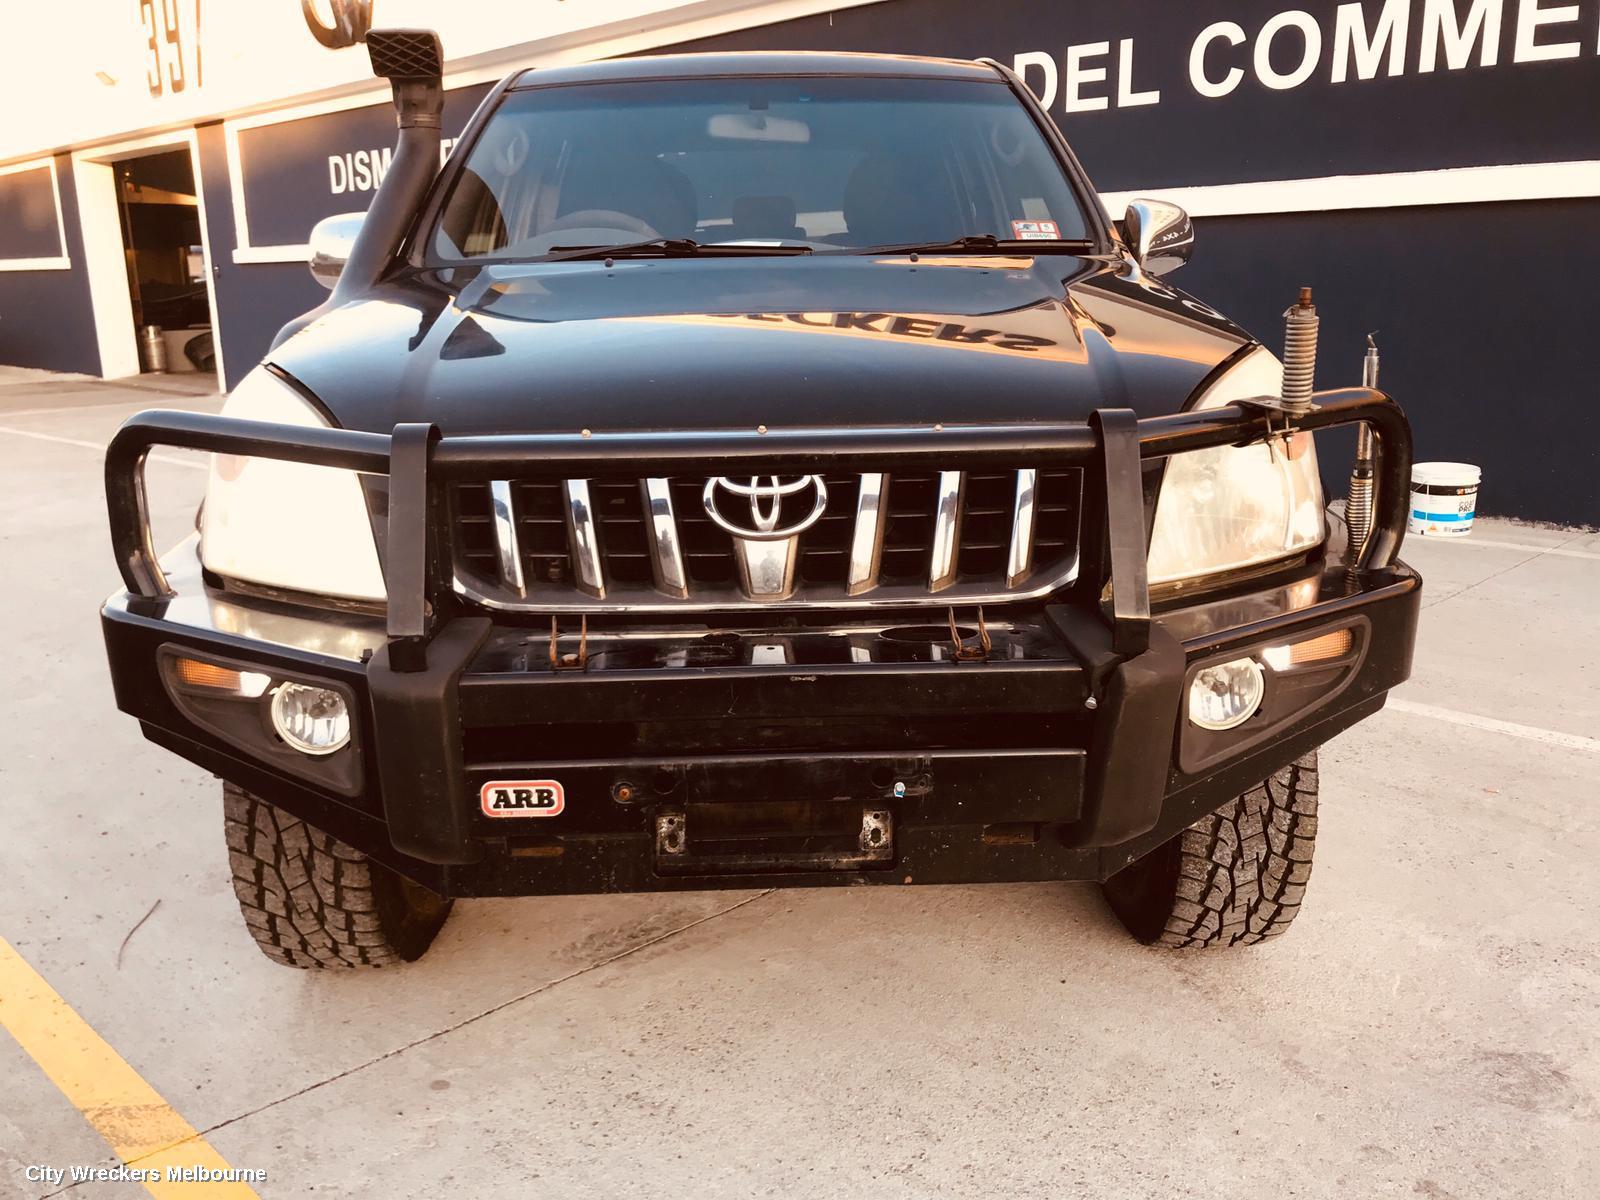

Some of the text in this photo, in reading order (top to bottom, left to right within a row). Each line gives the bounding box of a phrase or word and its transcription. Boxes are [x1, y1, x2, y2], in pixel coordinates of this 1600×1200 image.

[975, 0, 1600, 113] DEL COMME
[493, 789, 555, 809] ARB
